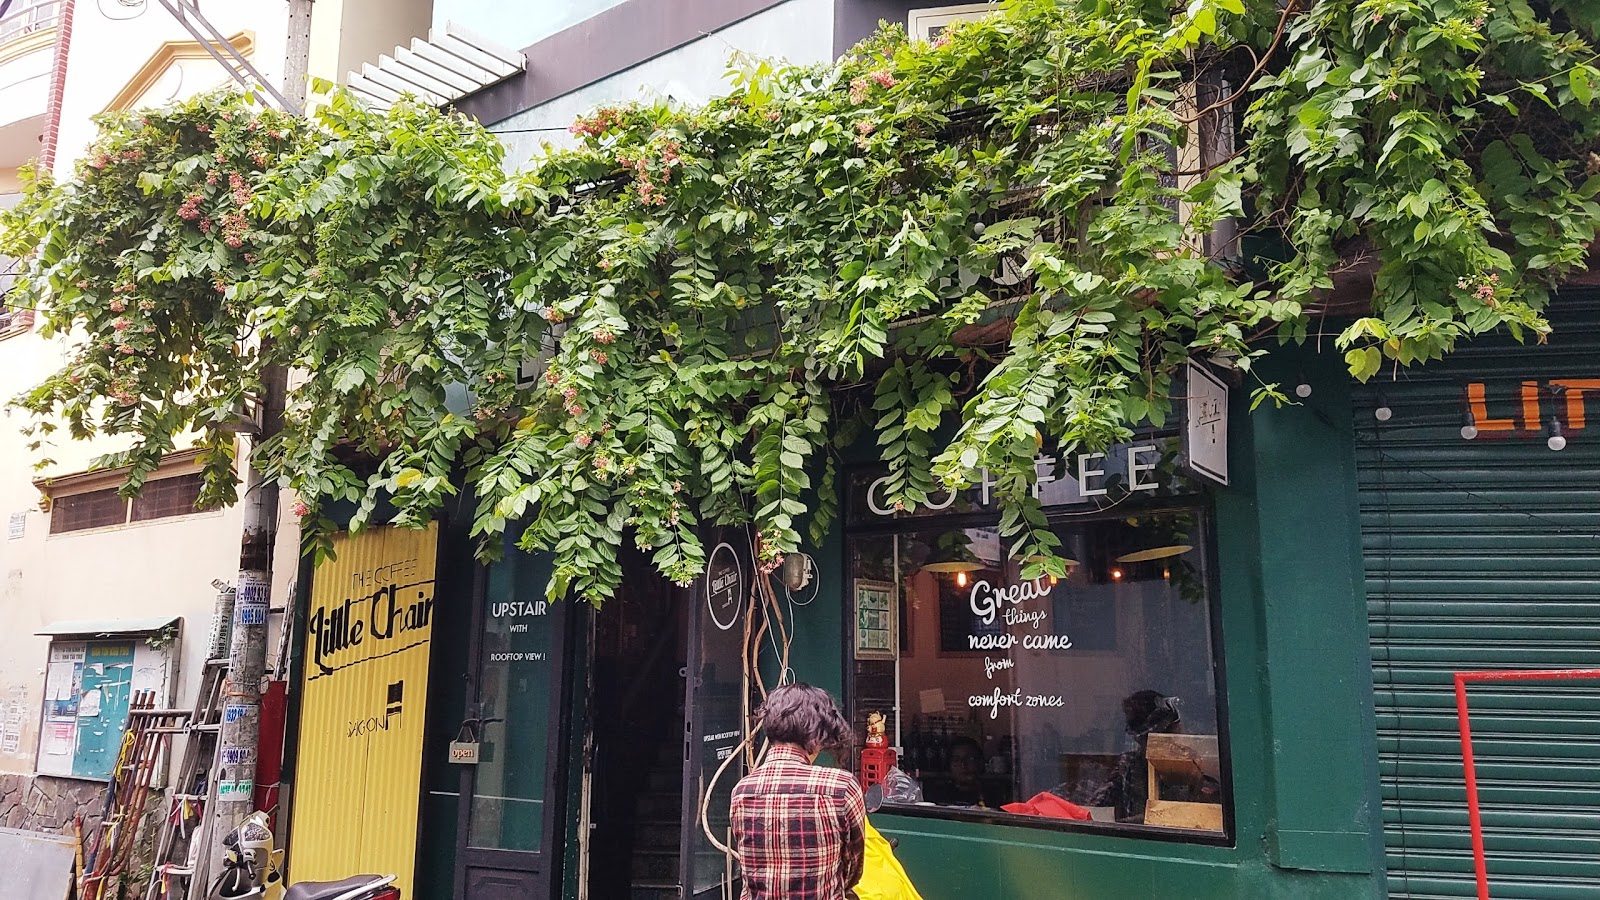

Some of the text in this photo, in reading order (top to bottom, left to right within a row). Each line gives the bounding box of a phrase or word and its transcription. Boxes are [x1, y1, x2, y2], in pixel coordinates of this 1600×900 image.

[492, 600, 547, 618] UPSTAIR
[970, 573, 1052, 625] Great
[370, 583, 434, 639] Chair
[1001, 607, 1047, 629] things
[509, 624, 528, 633] WITH
[967, 633, 1073, 650] never came
[490, 652, 523, 661] ROOFTOP
[524, 652, 541, 661] VIEW
[983, 656, 1015, 680] from
[968, 686, 1065, 720] comfort zones
[451, 749, 475, 759] open
